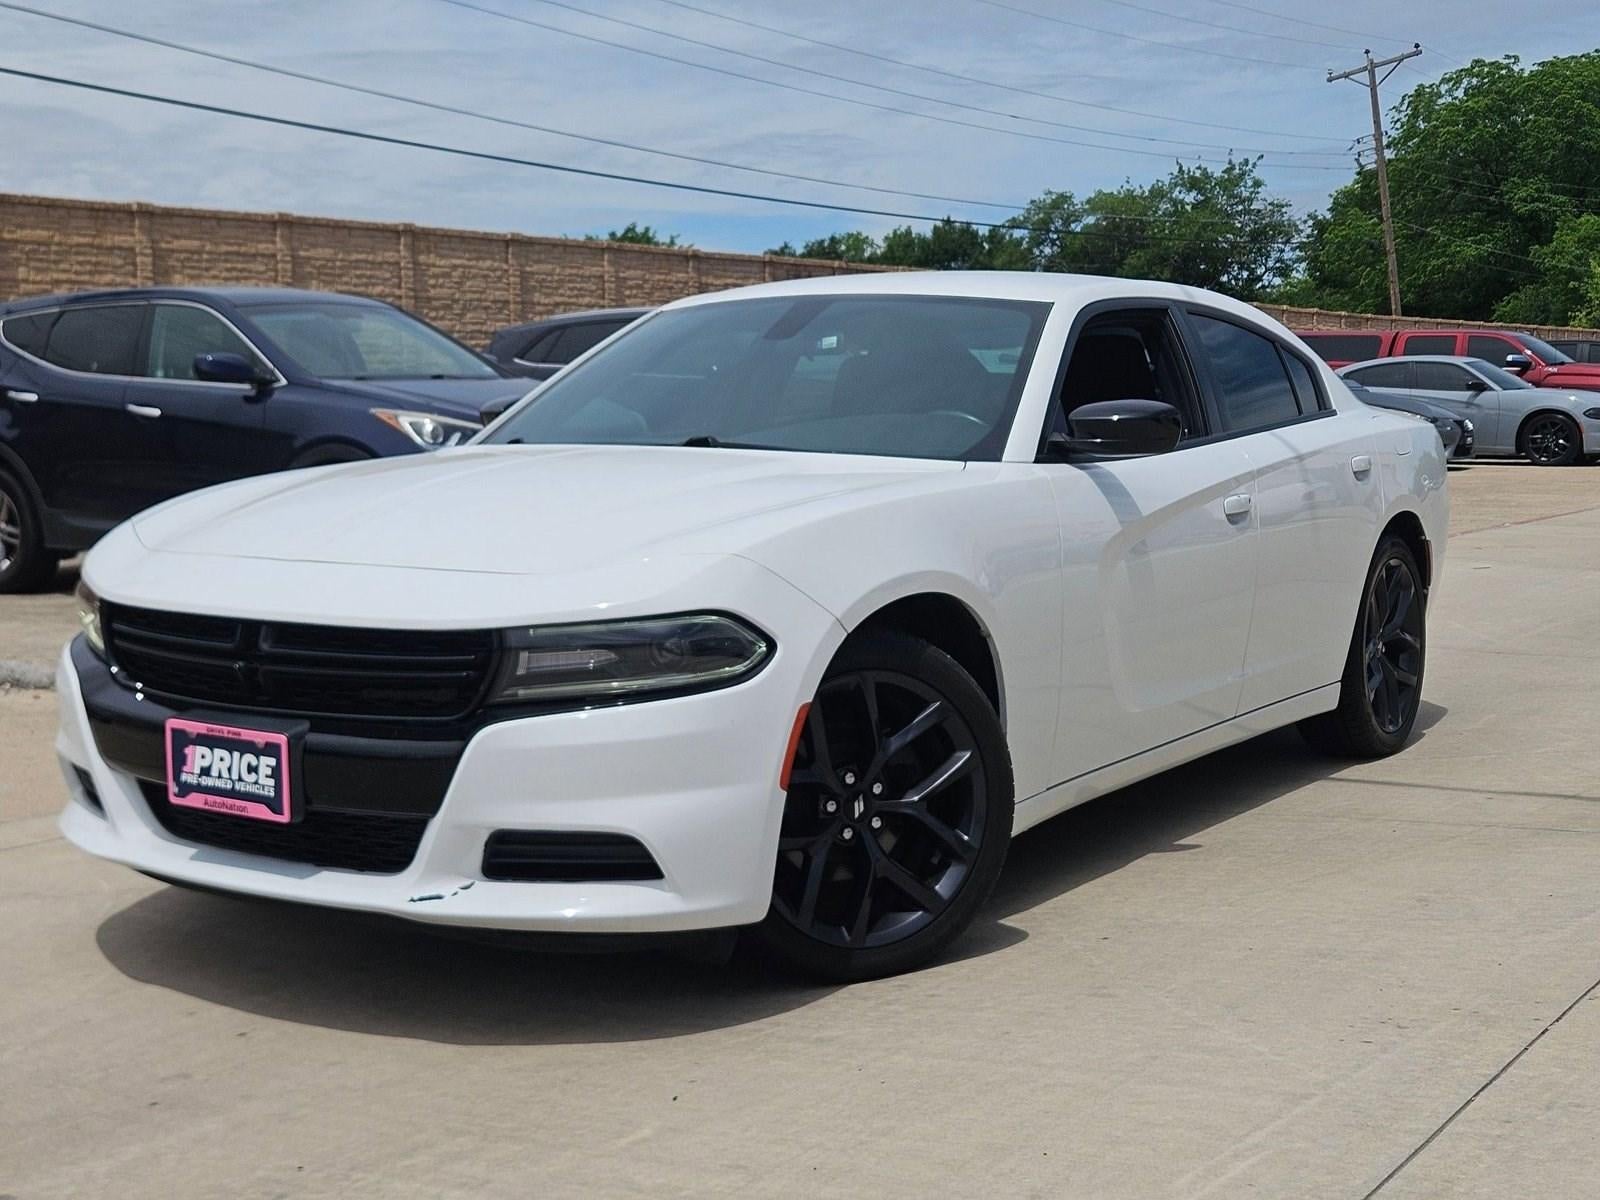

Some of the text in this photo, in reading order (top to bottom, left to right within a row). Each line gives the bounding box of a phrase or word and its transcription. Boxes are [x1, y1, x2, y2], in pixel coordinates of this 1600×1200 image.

[181, 773, 275, 797] PRE-OWNED VEHICLES
[204, 798, 249, 814] AutoNation
